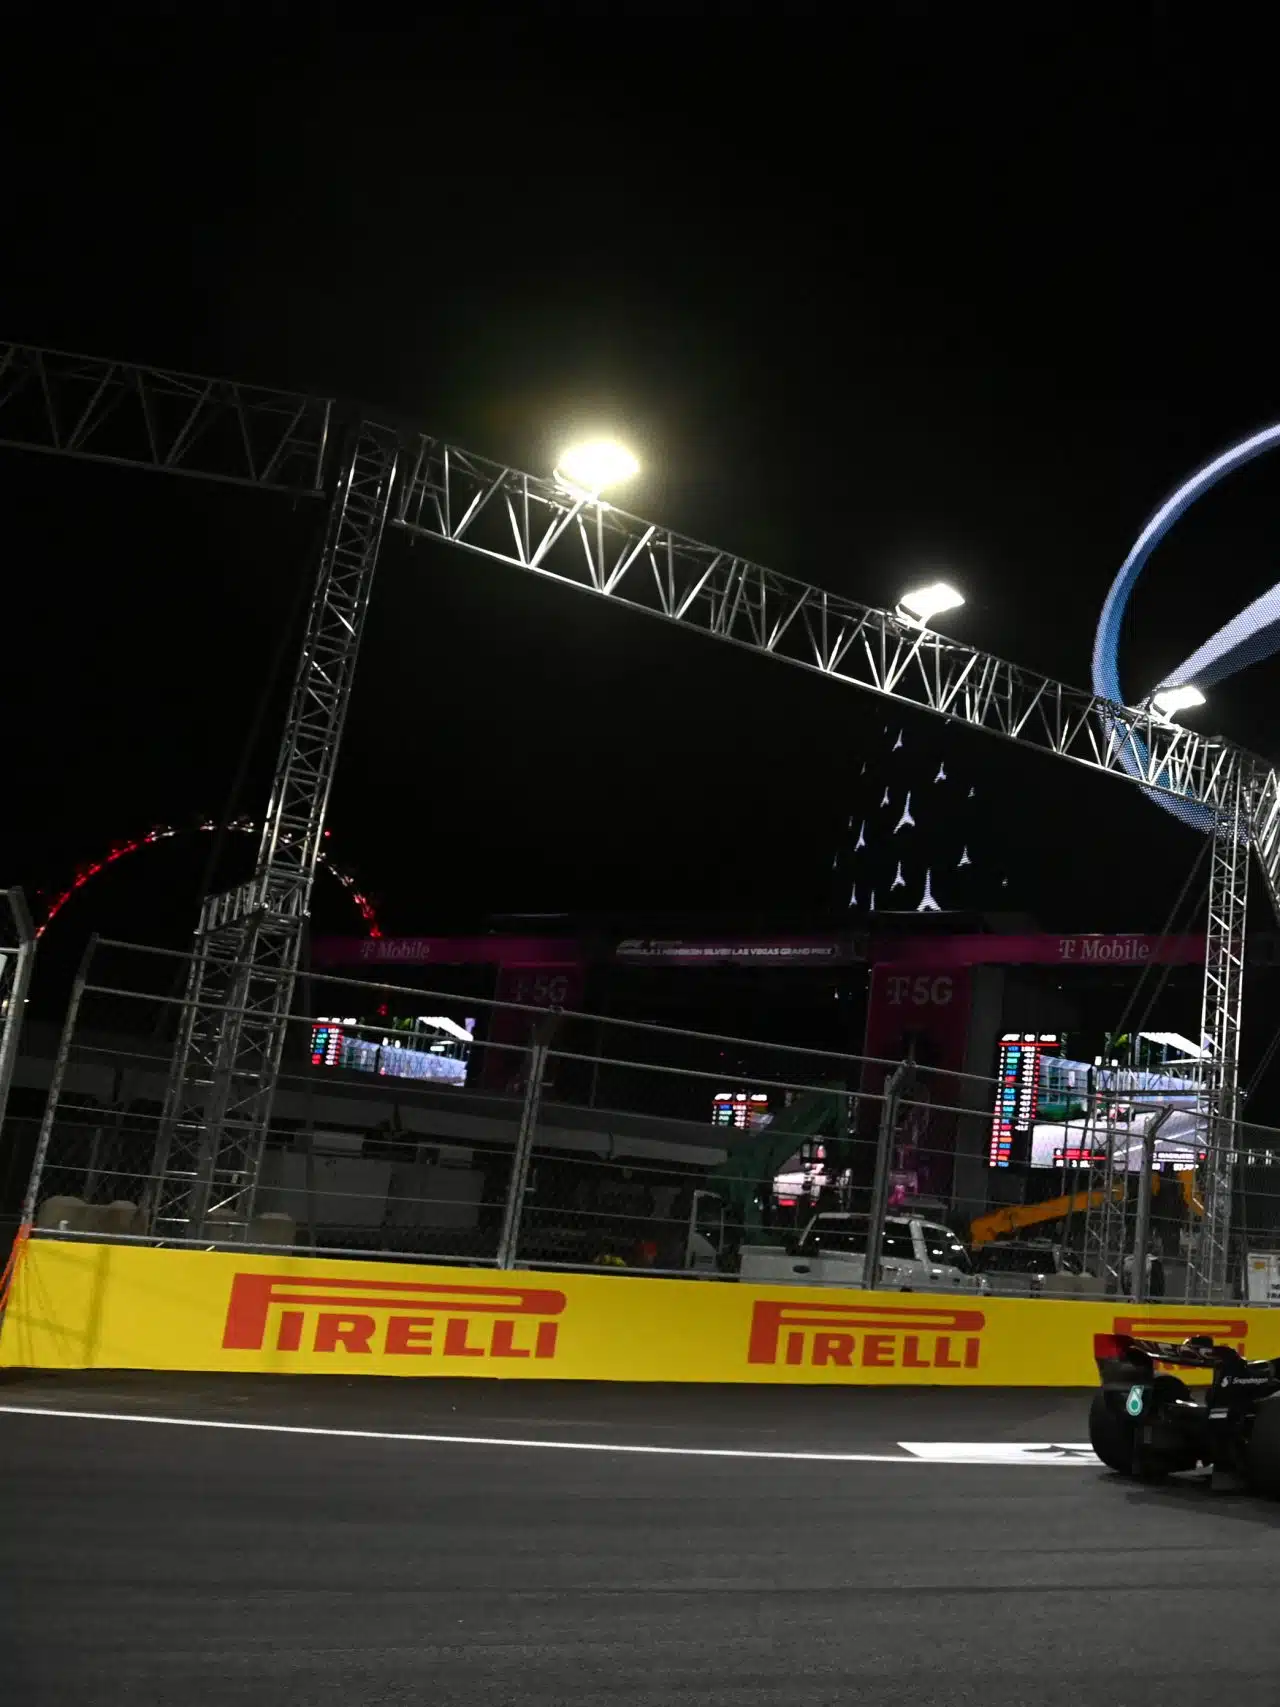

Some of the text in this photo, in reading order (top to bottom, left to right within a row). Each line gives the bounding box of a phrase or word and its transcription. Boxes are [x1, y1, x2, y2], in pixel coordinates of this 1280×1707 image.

[377, 940, 430, 960] Mobile
[1080, 939, 1149, 960] Mobile
[912, 976, 952, 1005] 5G
[222, 1272, 567, 1359] PIRELLI
[747, 1300, 985, 1369] PIRELLI
